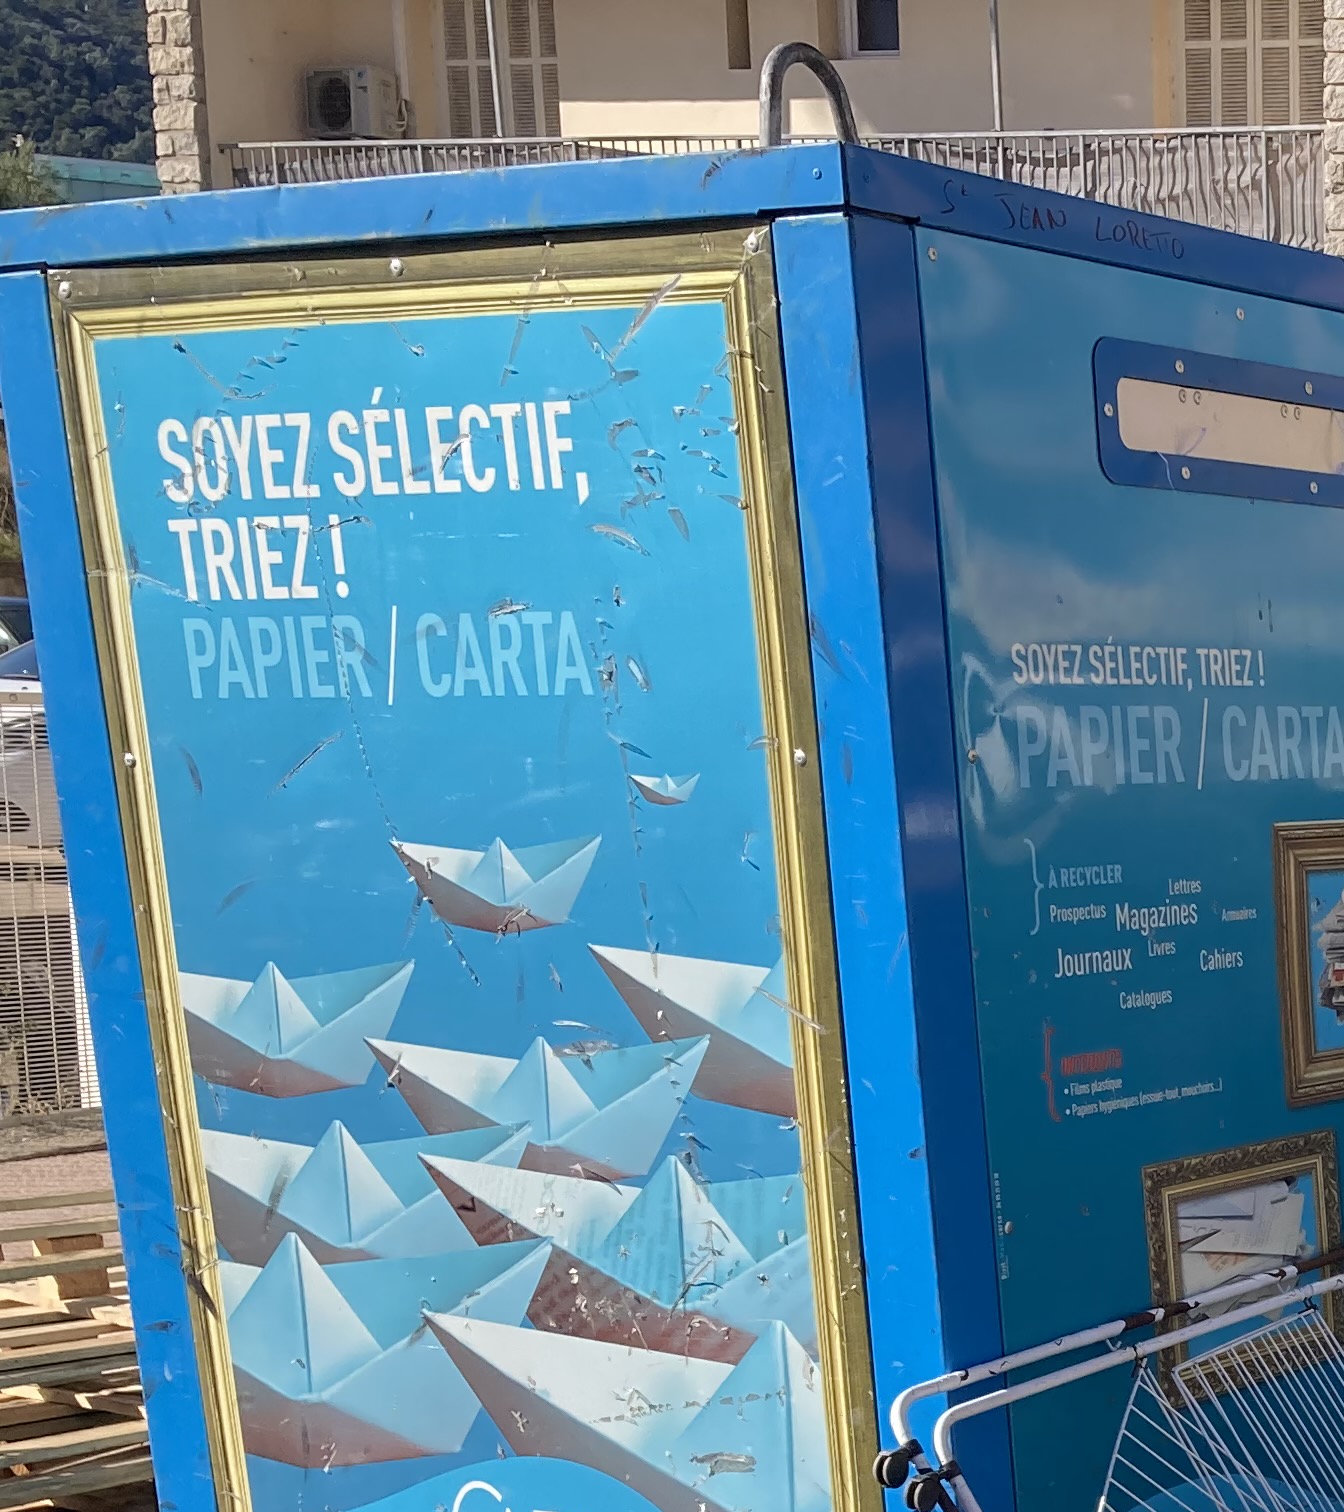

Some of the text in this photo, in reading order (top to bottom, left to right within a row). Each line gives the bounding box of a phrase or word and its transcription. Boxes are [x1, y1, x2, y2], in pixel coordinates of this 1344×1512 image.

[994, 192, 1067, 231] JEAN
[1096, 217, 1185, 261] LORETTO
[157, 387, 589, 506] SOYEZ SÉLECTIF,
[167, 514, 319, 602] TRIEZ
[183, 614, 373, 699] PAPIER
[415, 609, 595, 698] CARTA
[1011, 643, 1084, 687] SOYEZ
[1088, 636, 1194, 692] SÉLECTIF,
[1196, 648, 1253, 687] TRIEZ
[1015, 704, 1186, 790] PAPIER
[1060, 864, 1123, 888] RECYCLER
[1168, 877, 1202, 896] Lettres
[1049, 902, 1107, 926] Prospectus
[1114, 897, 1199, 937] Magazines
[1053, 947, 1133, 980] Journaux
[1147, 939, 1177, 958] Livres
[1199, 947, 1245, 973] Cahiers
[1118, 988, 1174, 1011] Catalogues
[1090, 1076, 1124, 1097] plastique
